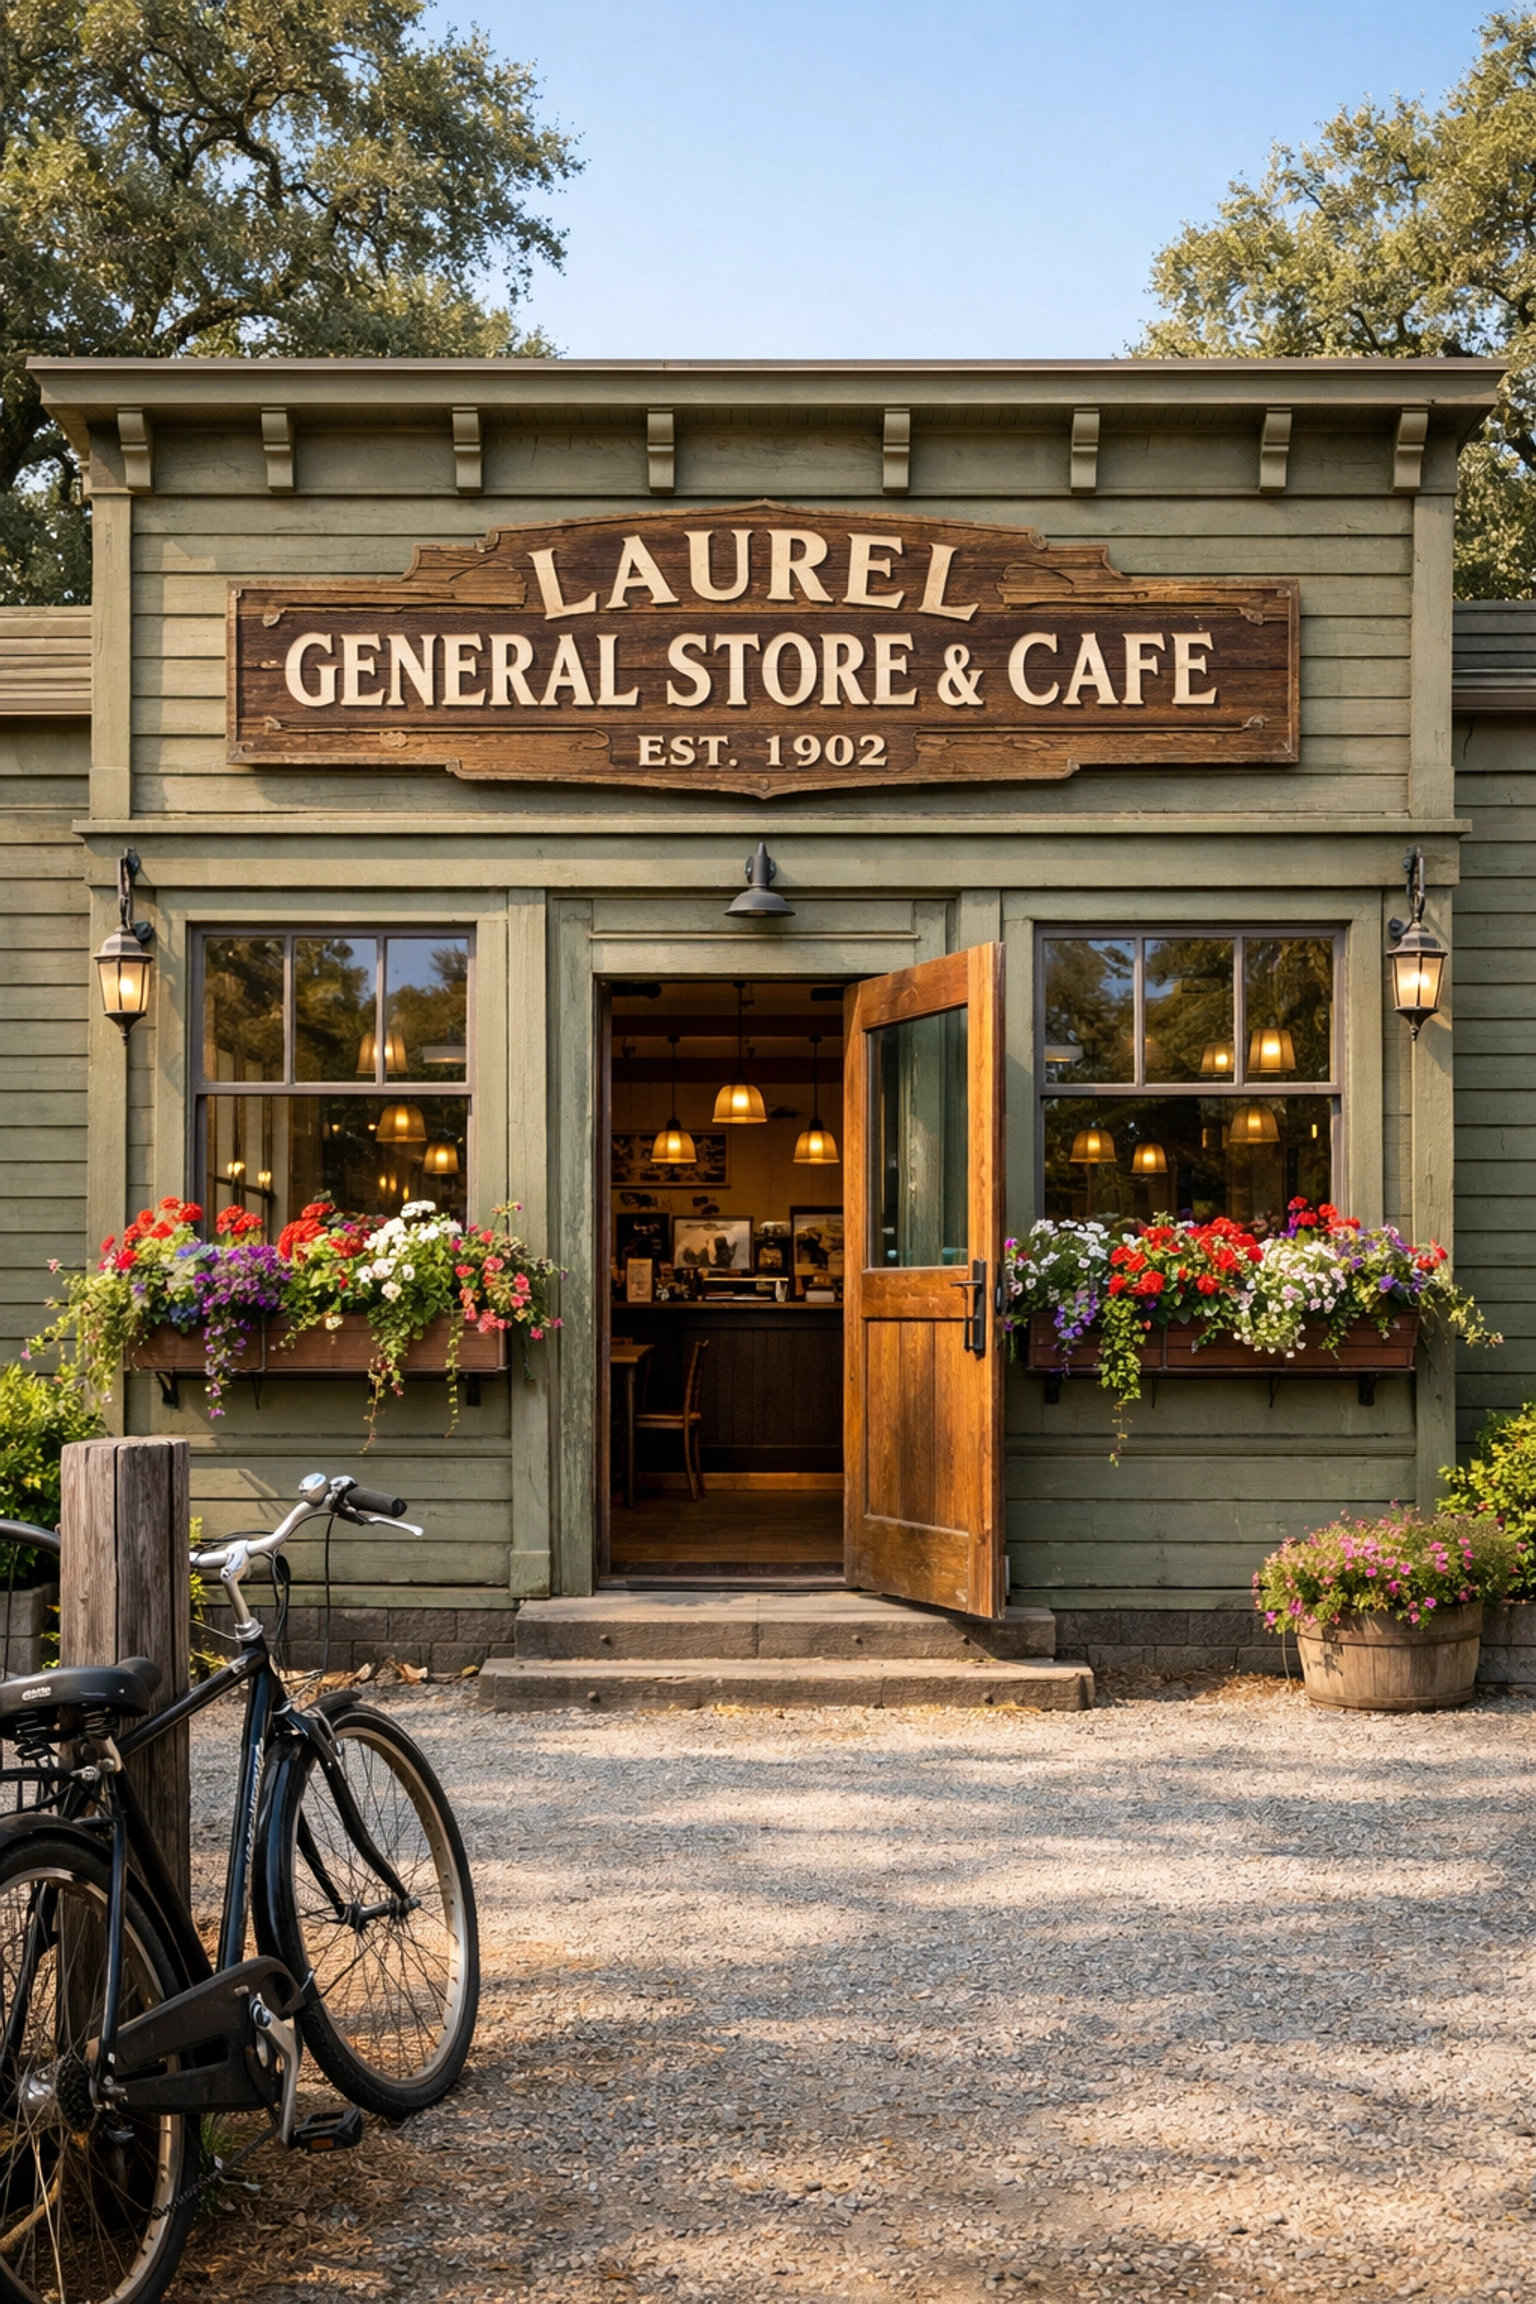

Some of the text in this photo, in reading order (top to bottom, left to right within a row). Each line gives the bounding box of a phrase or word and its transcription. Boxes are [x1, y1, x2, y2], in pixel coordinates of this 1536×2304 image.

[527, 529, 979, 621] LAUREL
[284, 632, 1218, 707] GENERAL STORE & CAFE
[637, 734, 888, 767] EST. 1902
